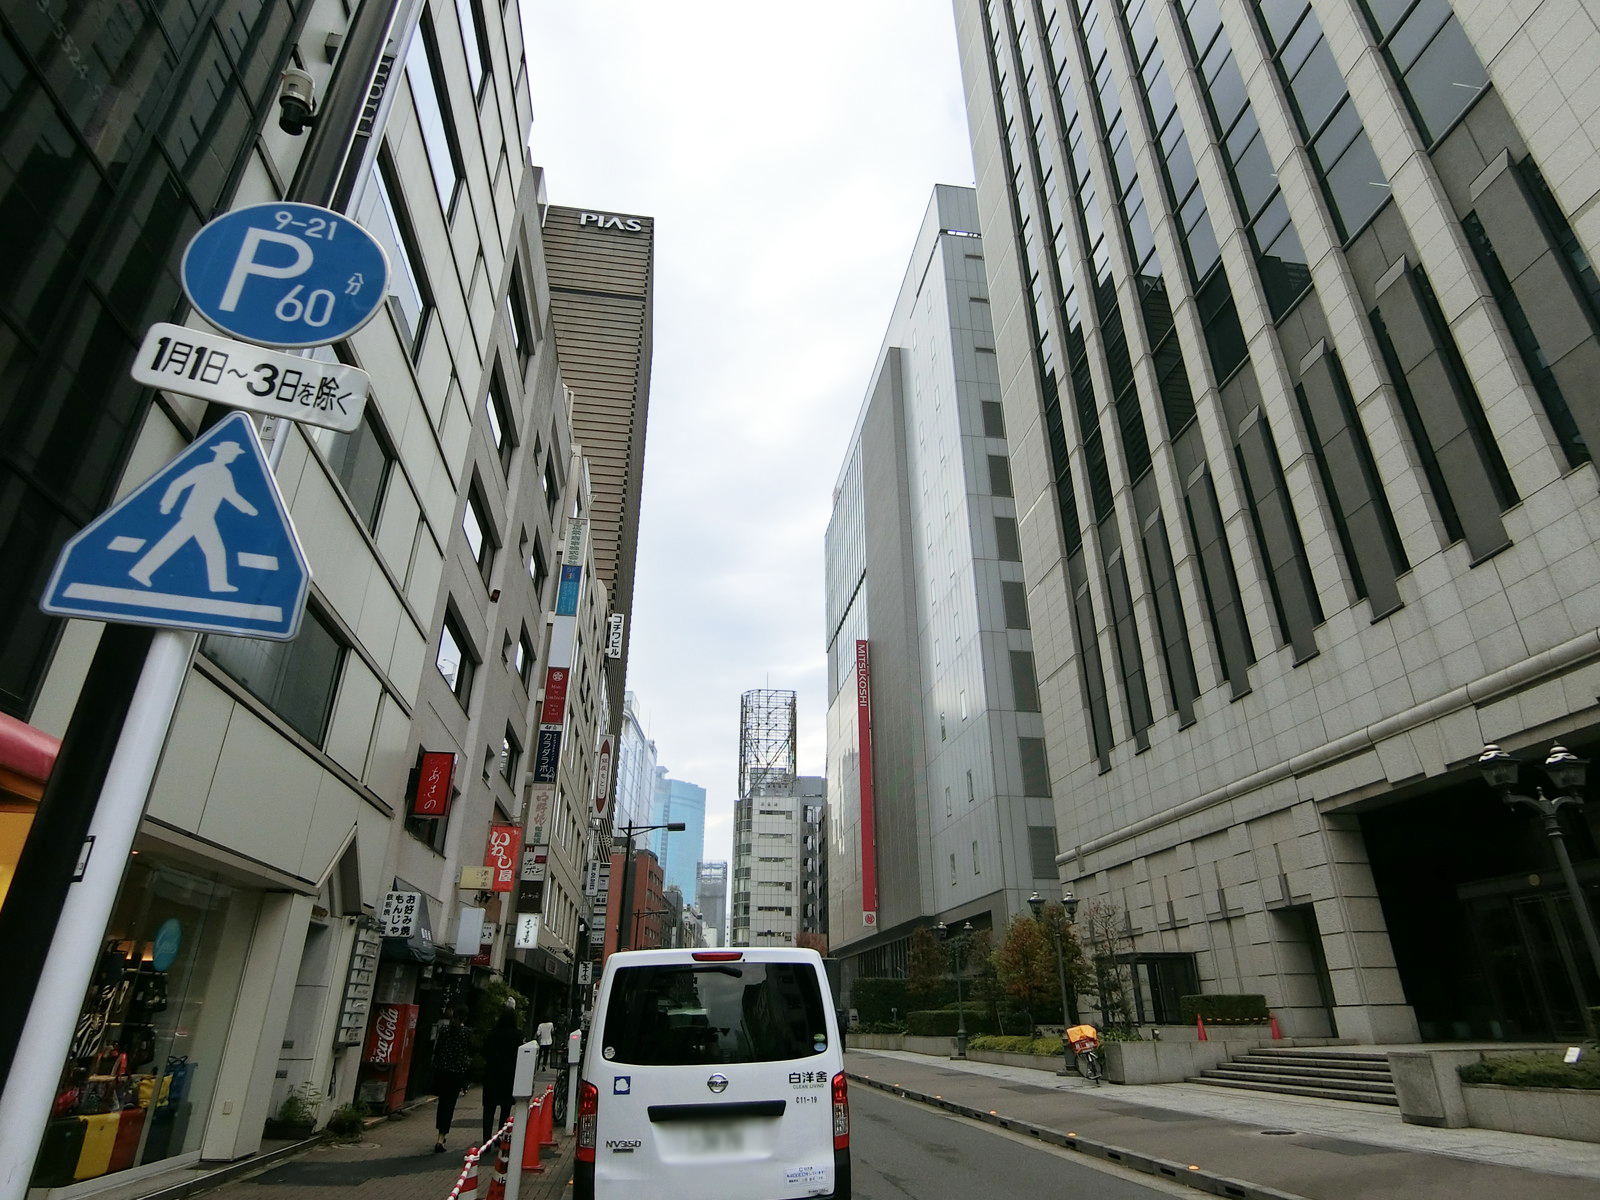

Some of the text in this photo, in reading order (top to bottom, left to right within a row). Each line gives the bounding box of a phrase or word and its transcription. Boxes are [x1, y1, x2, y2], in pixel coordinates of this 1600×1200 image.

[274, 210, 338, 241] 9-21
[580, 213, 642, 232] PIAS
[218, 226, 314, 313] P
[275, 272, 365, 328] 60 分
[610, 615, 622, 656] コチワビル
[857, 645, 867, 706] MITSUKOSHI
[539, 733, 553, 772] カラダラボ
[424, 767, 441, 810] あさの
[490, 831, 512, 882] いわし屋
[399, 895, 416, 936] お好み焼
[606, 1140, 641, 1148] NV350
